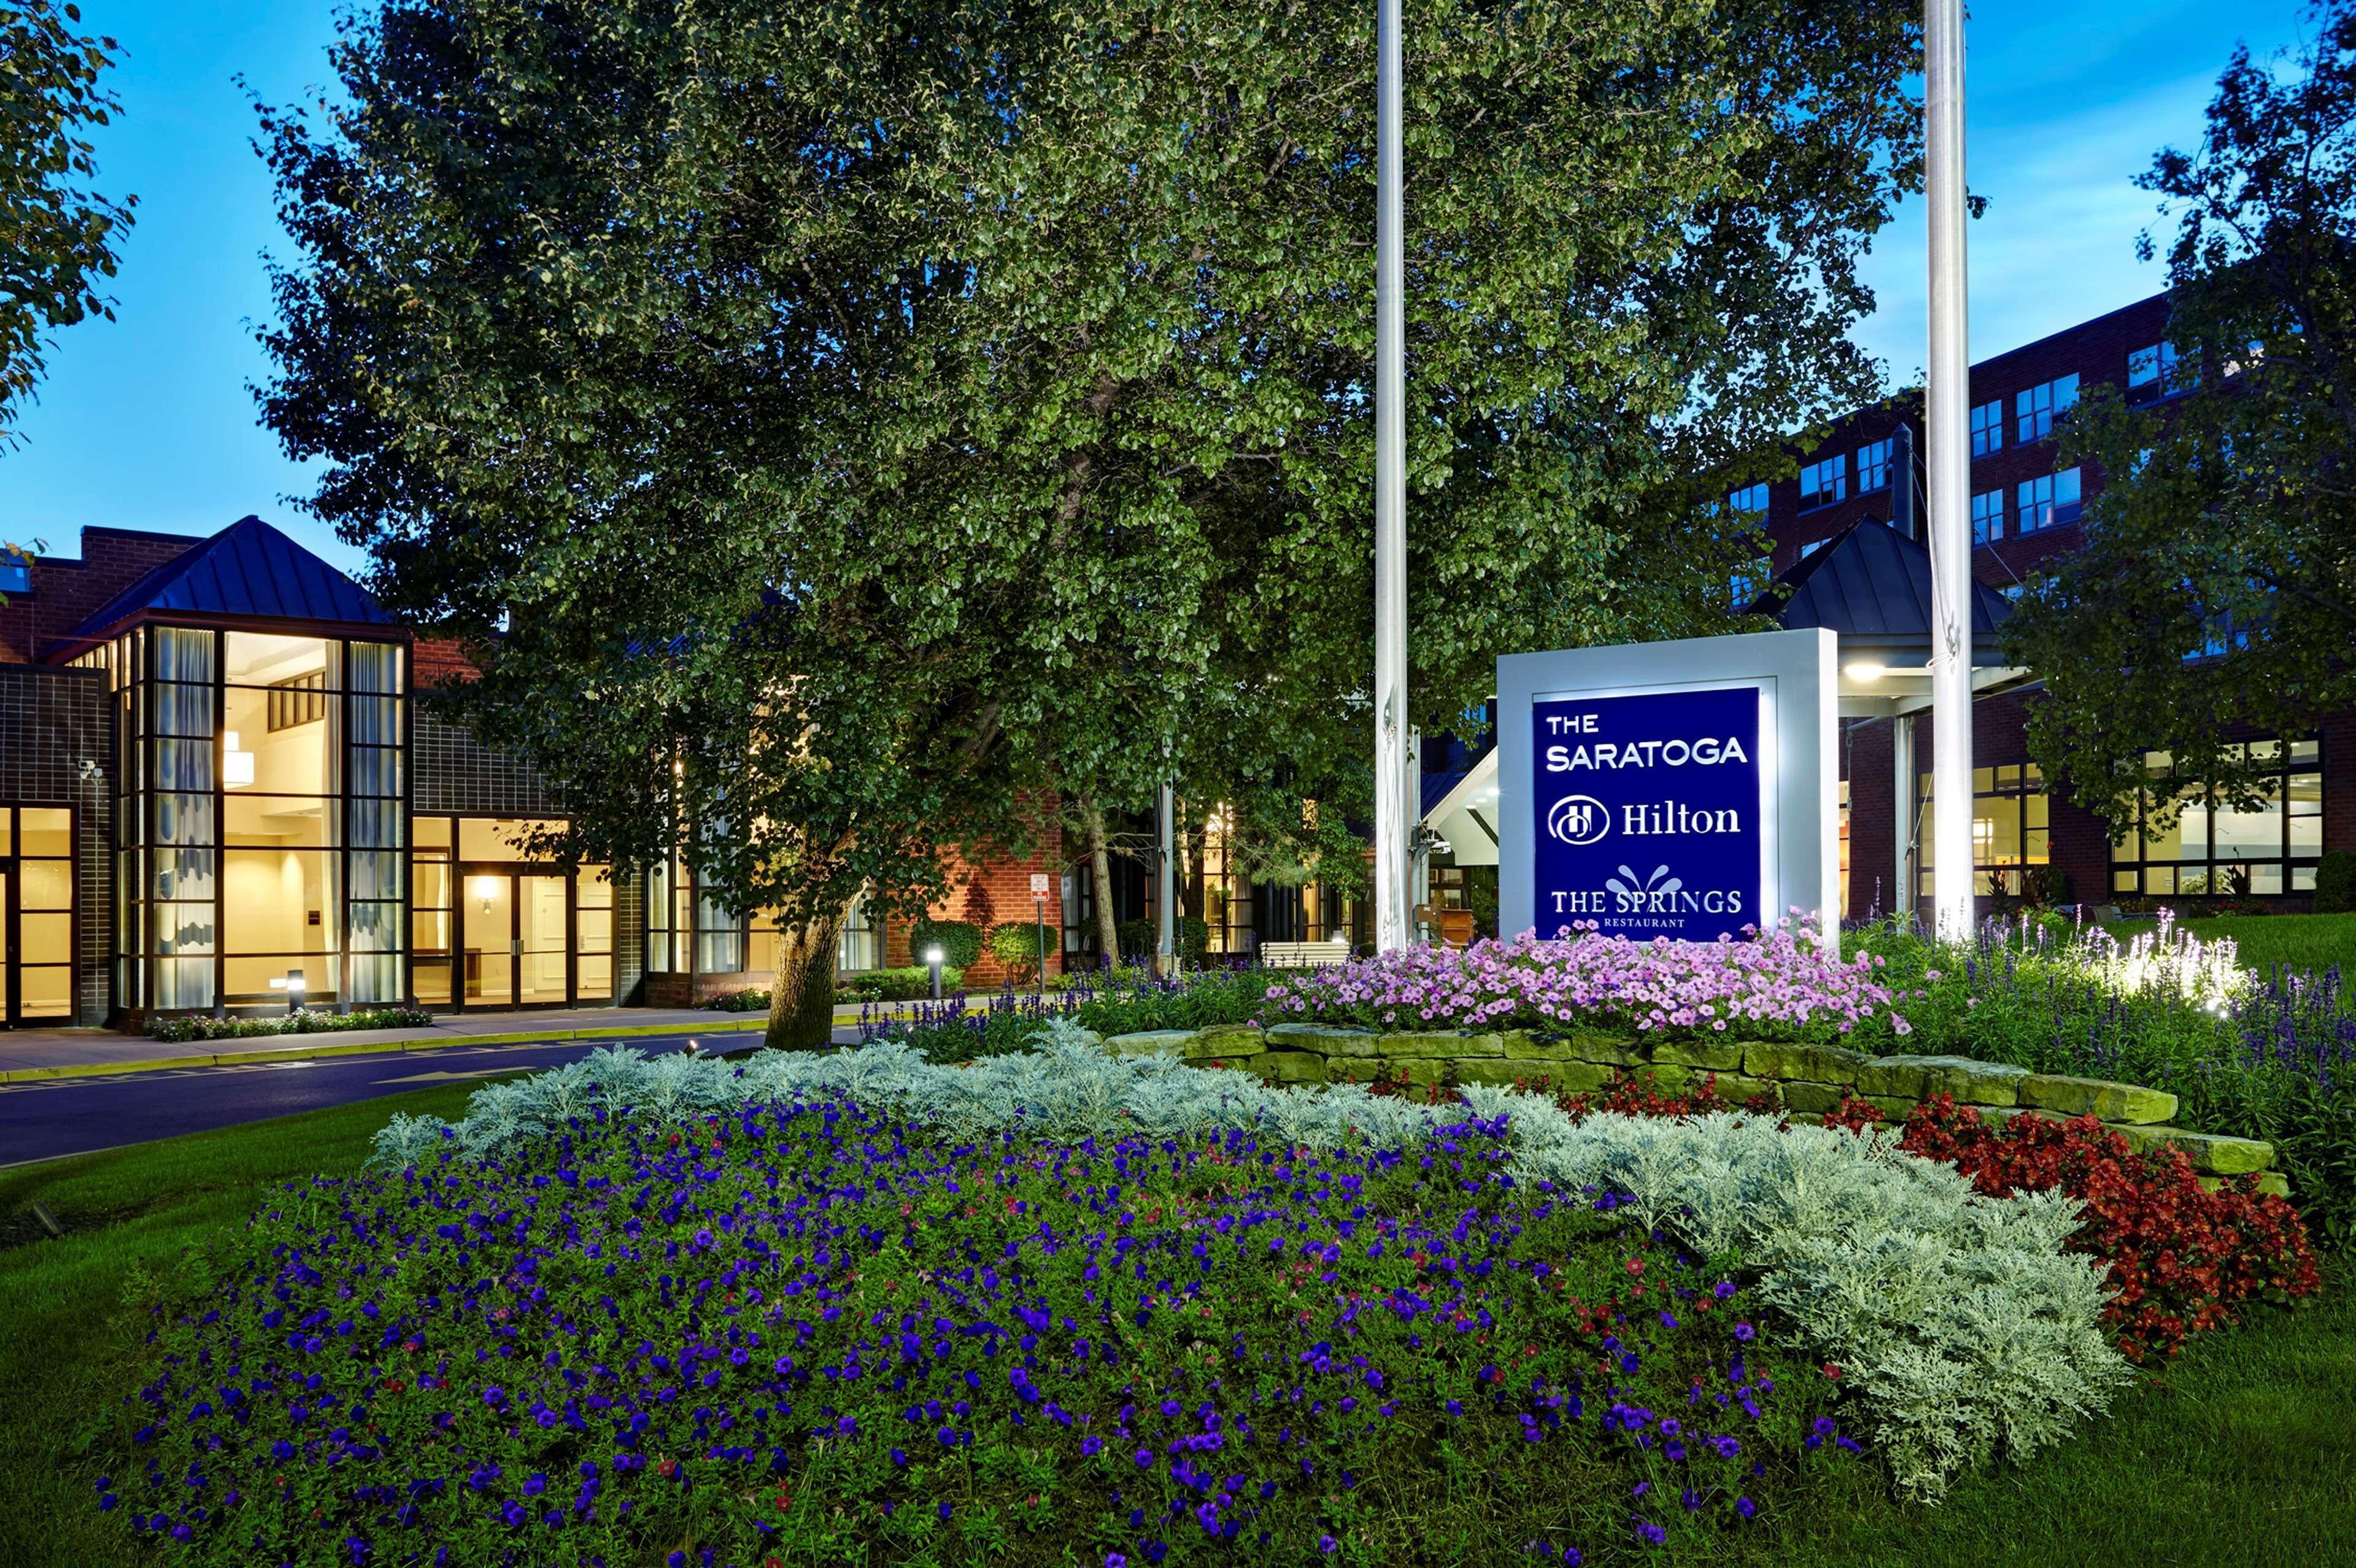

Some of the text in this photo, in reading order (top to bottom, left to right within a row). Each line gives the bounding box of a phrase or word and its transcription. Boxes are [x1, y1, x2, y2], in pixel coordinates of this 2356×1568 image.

[1546, 714, 1599, 735] THE
[1546, 736, 1748, 773] SARATOGA
[1621, 800, 1741, 835] Hilton
[1551, 890, 1742, 913] THE SPRINGS
[1604, 917, 1685, 928] RESTAURANT
